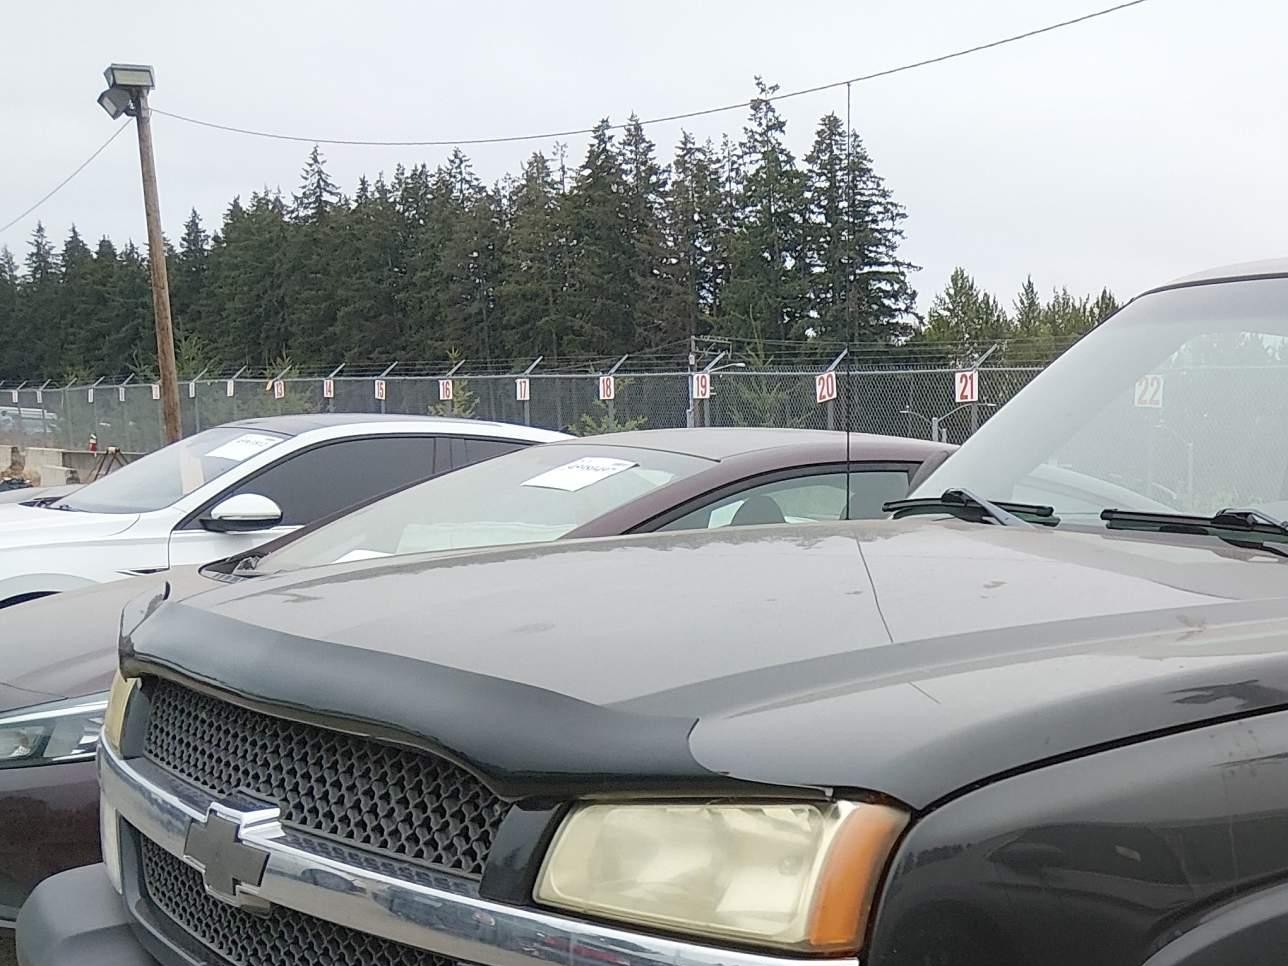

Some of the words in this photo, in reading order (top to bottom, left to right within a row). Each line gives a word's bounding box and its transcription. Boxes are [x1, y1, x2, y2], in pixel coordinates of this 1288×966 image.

[376, 381, 384, 398] 15
[441, 381, 450, 398] 16
[519, 380, 527, 398] 17
[602, 377, 612, 398] 18
[695, 375, 707, 397] 19
[818, 374, 834, 400] 20
[959, 373, 974, 400] 21
[1137, 376, 1161, 404] 22
